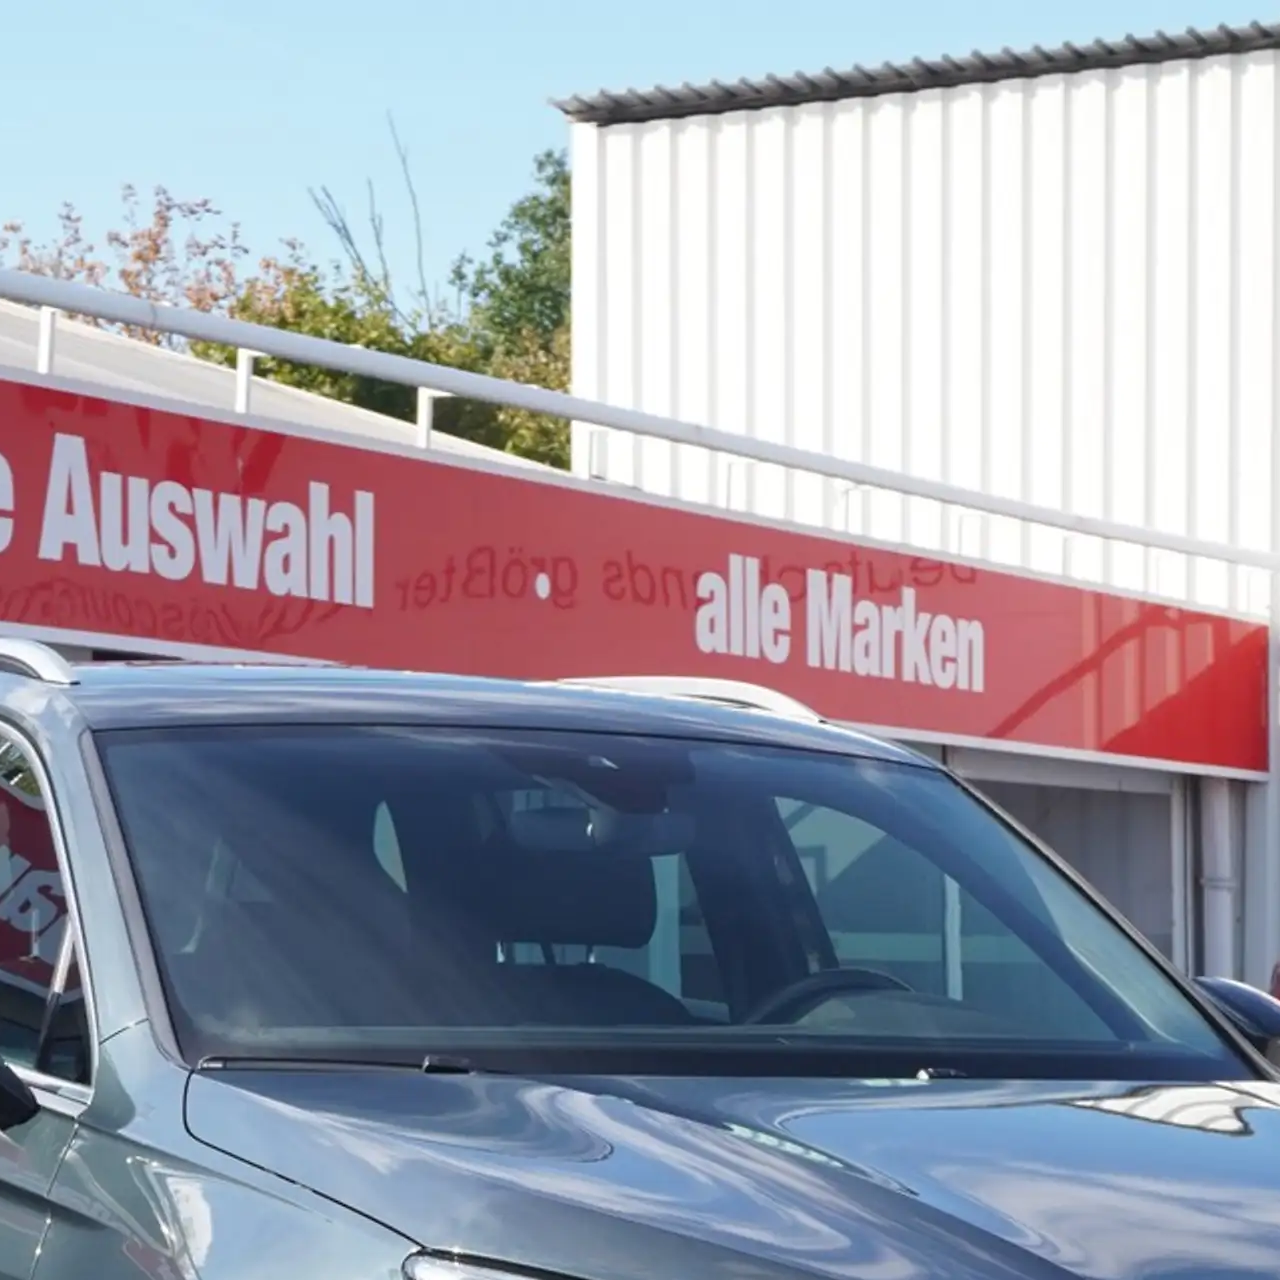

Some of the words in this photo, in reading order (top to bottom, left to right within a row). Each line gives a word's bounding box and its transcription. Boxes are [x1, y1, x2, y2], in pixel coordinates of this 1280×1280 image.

[38, 432, 375, 609] Auswahl
[695, 553, 792, 664] alle
[806, 568, 985, 692] Marken
